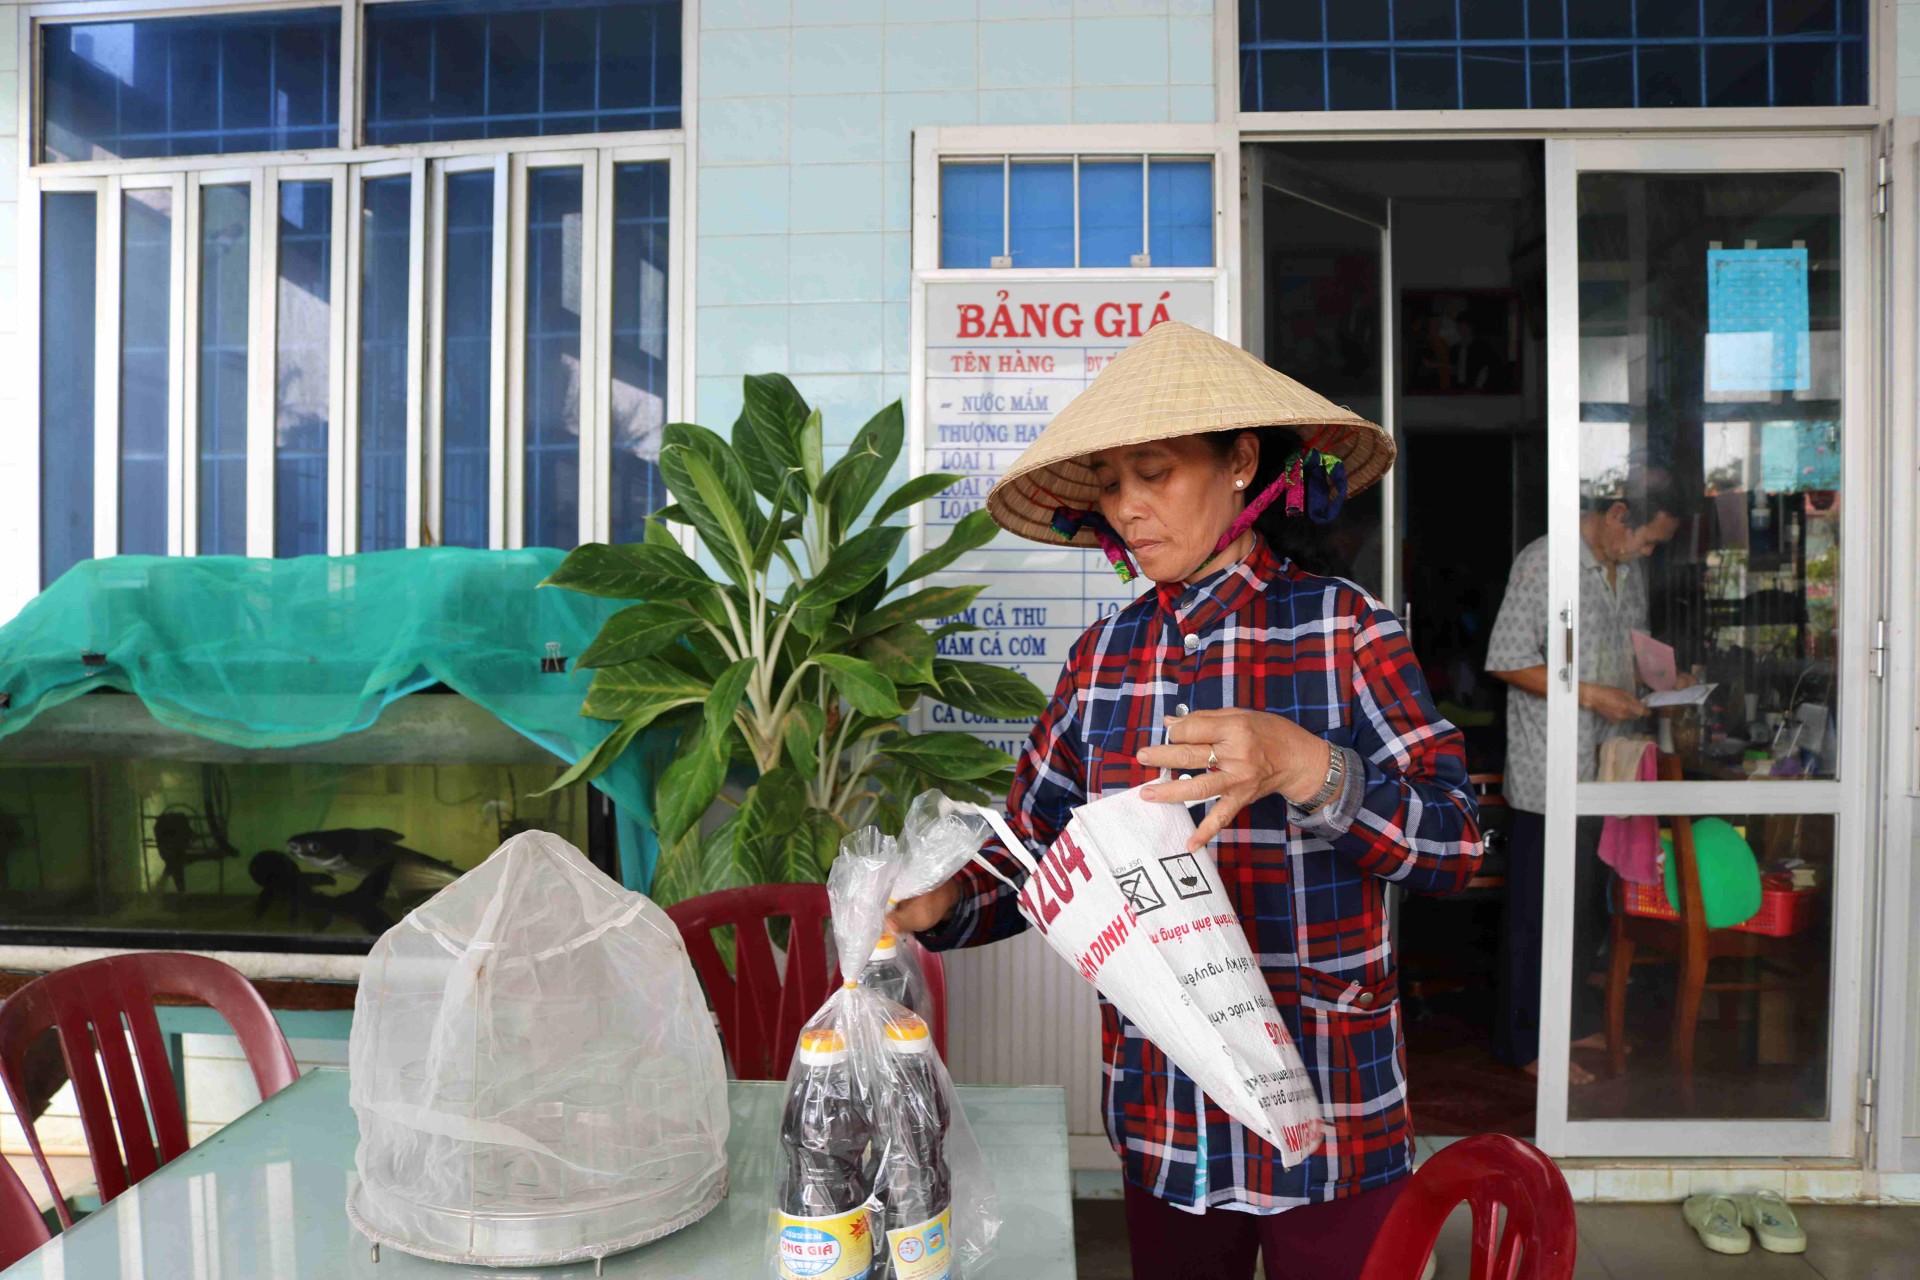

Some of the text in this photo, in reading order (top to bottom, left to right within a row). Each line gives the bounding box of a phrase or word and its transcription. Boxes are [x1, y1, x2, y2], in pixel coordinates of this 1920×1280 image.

[956, 290, 1172, 339] BẢNG GIÁ
[951, 351, 991, 373] TÊN
[998, 349, 1055, 373] HÀNG
[962, 387, 1049, 411] NƯỚC MẮM
[938, 421, 1009, 447] THƯỢNG
[988, 452, 996, 470] 1
[982, 602, 1008, 626] CÁ
[1012, 607, 1047, 626] THU
[979, 632, 1004, 656] CÁ
[1009, 634, 1046, 657] CƠM
[1160, 923, 1190, 944] nắng
[1191, 916, 1212, 933] ánh
[1089, 914, 1129, 966] DINH
